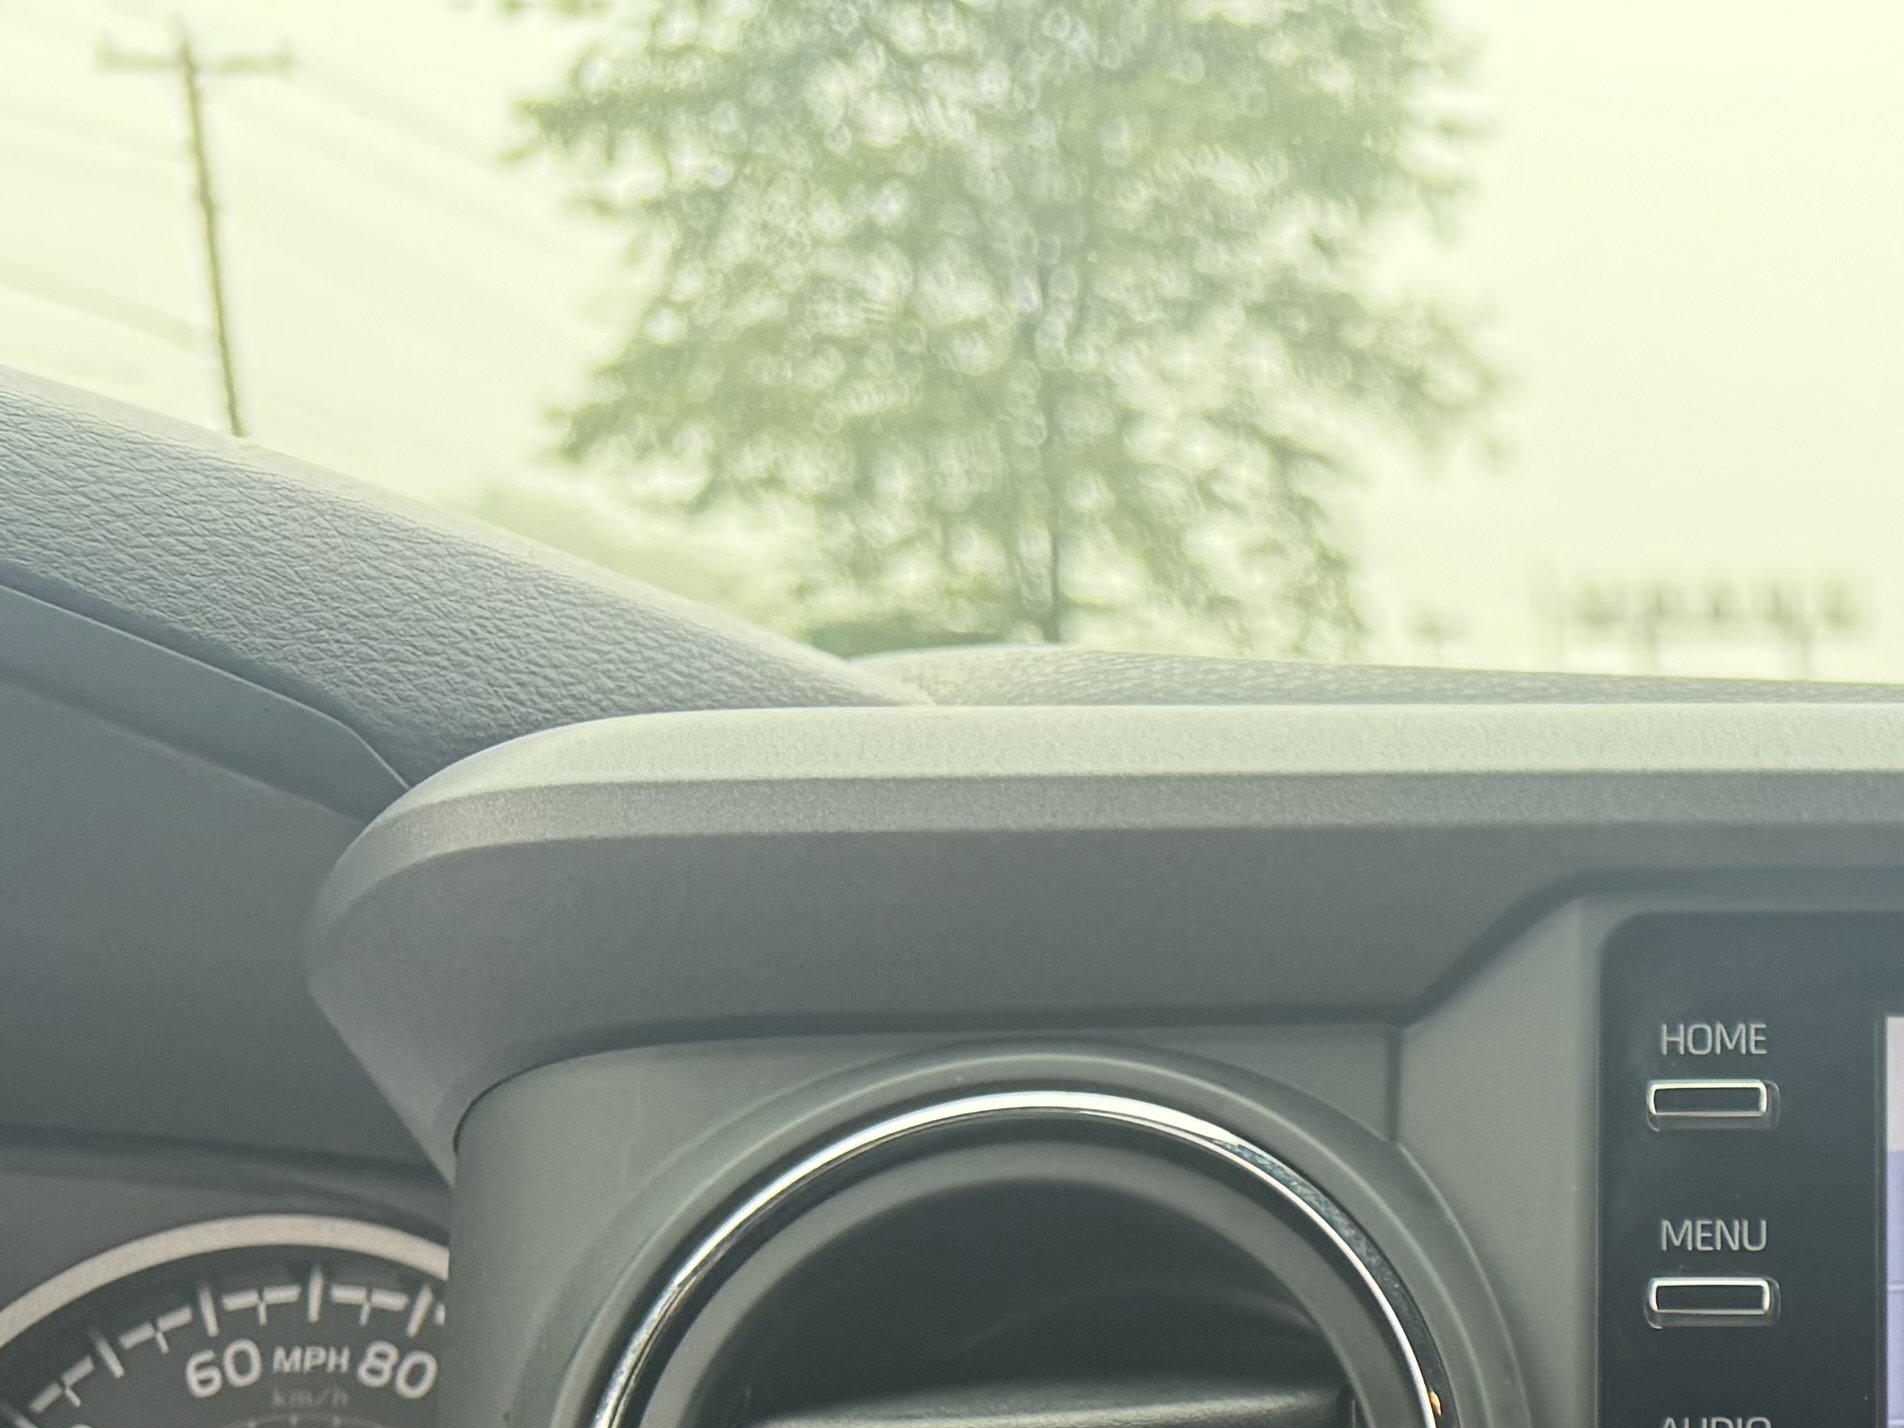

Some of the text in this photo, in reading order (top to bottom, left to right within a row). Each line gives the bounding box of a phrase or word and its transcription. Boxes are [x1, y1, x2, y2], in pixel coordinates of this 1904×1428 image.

[1661, 1022, 1767, 1055] HOME
[1661, 1219, 1767, 1252] MENU
[185, 1339, 262, 1398] 60
[272, 1346, 349, 1374] MPH
[357, 1341, 438, 1399] 80
